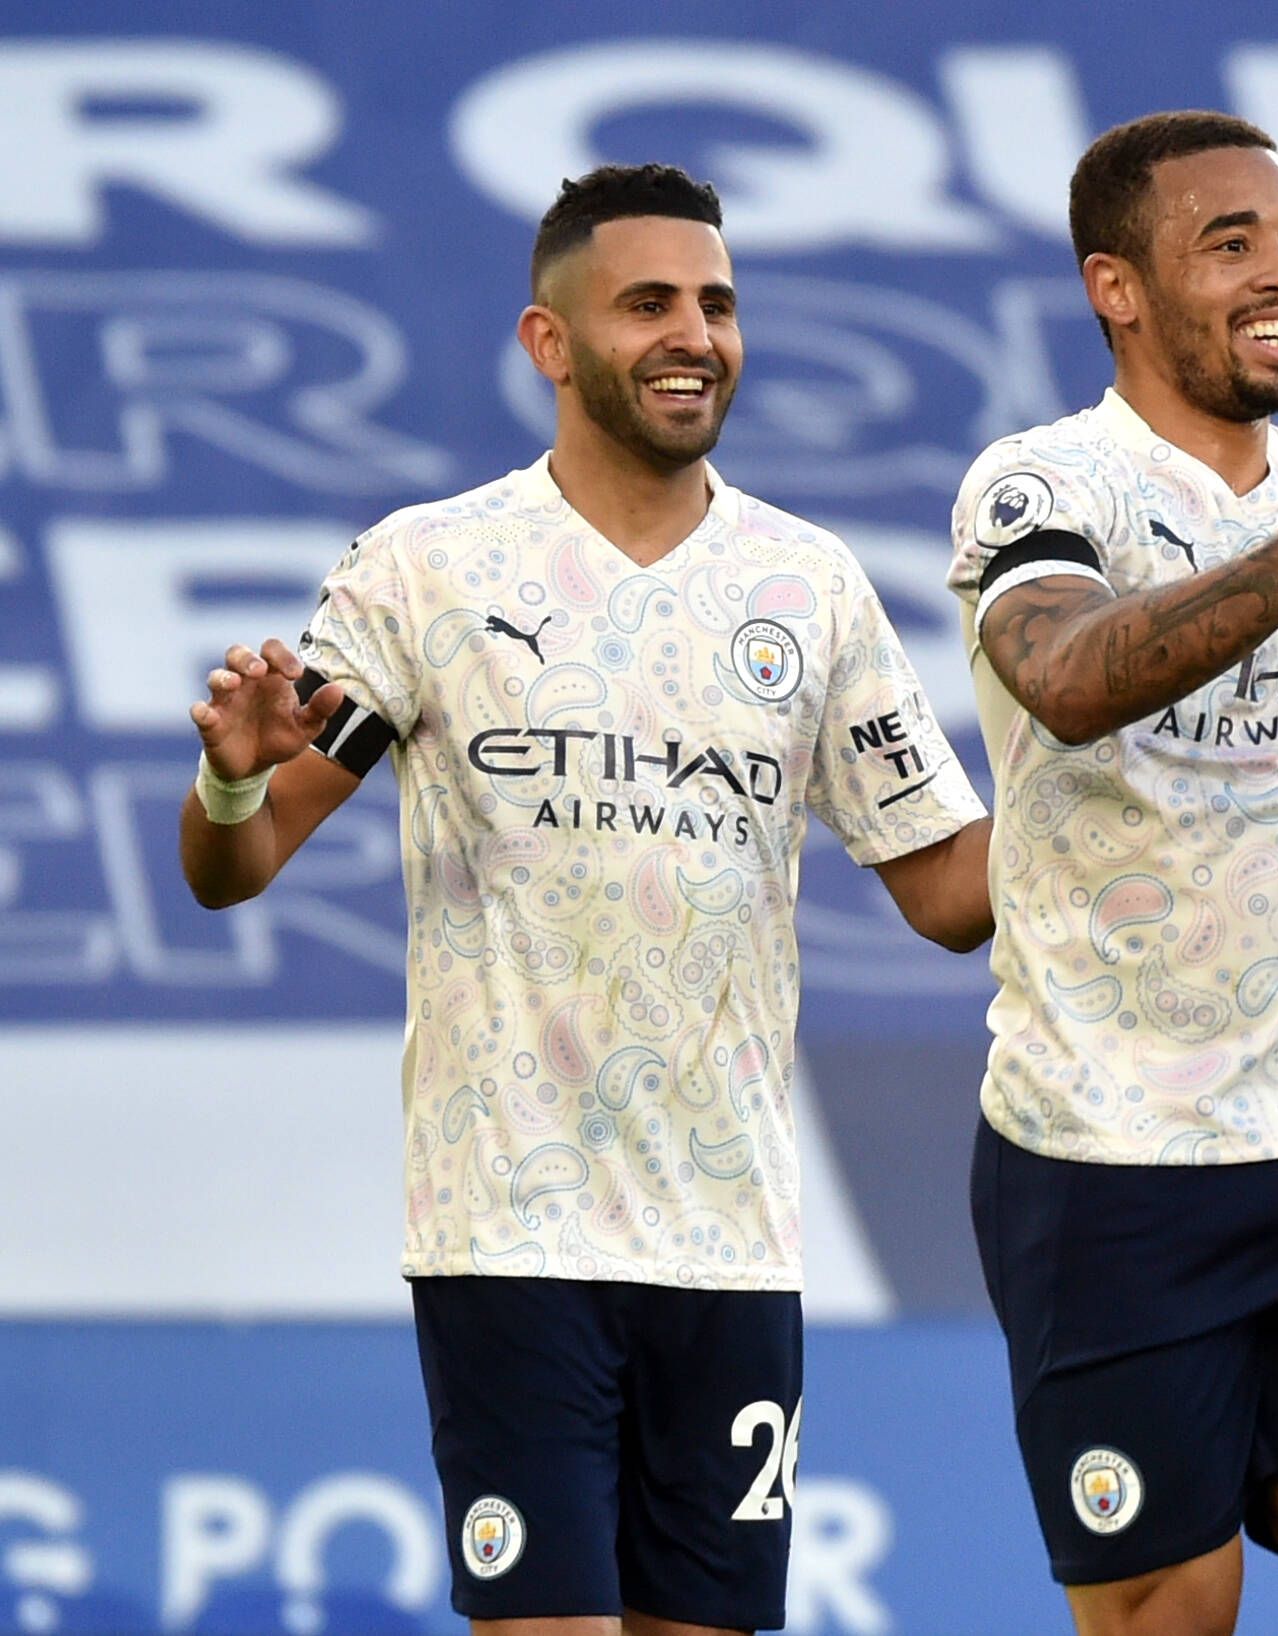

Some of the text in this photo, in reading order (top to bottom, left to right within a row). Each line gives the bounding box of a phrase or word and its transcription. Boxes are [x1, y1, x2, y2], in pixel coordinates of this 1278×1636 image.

[738, 625, 795, 656] MANCHESTER
[756, 686, 777, 697] CITY
[467, 728, 783, 806] ETIHAD
[532, 798, 750, 847] AIRWAYS
